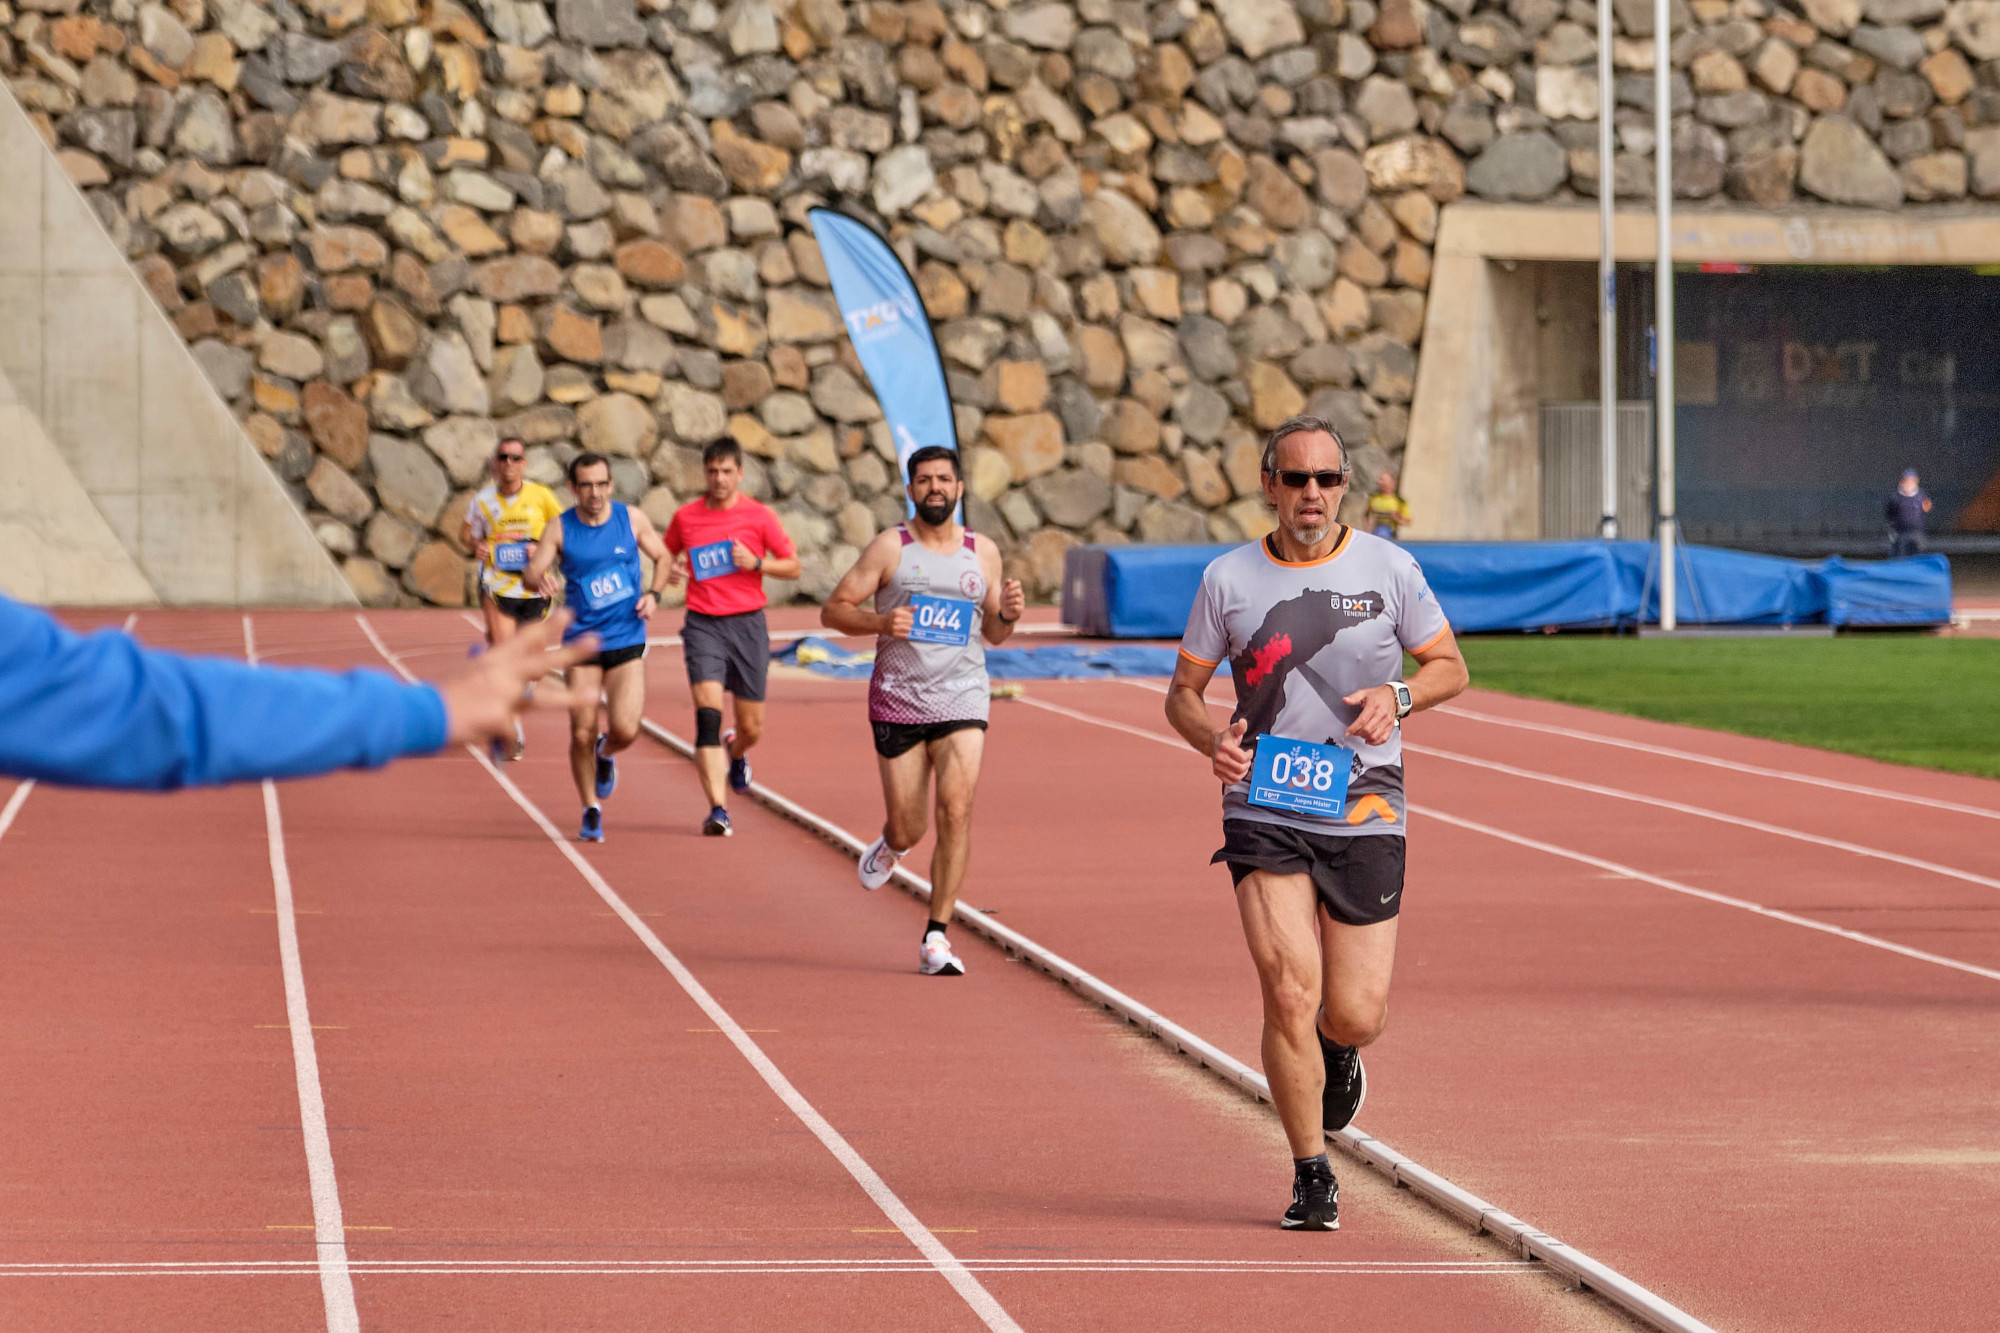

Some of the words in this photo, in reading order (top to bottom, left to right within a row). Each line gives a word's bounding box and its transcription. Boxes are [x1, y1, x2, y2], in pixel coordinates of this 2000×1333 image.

[698, 546, 729, 569] 011
[590, 572, 622, 598] 061
[1342, 598, 1373, 611] DXT
[1343, 610, 1371, 618] TENERIFE
[919, 605, 961, 631] 044
[1271, 752, 1334, 791] 038
